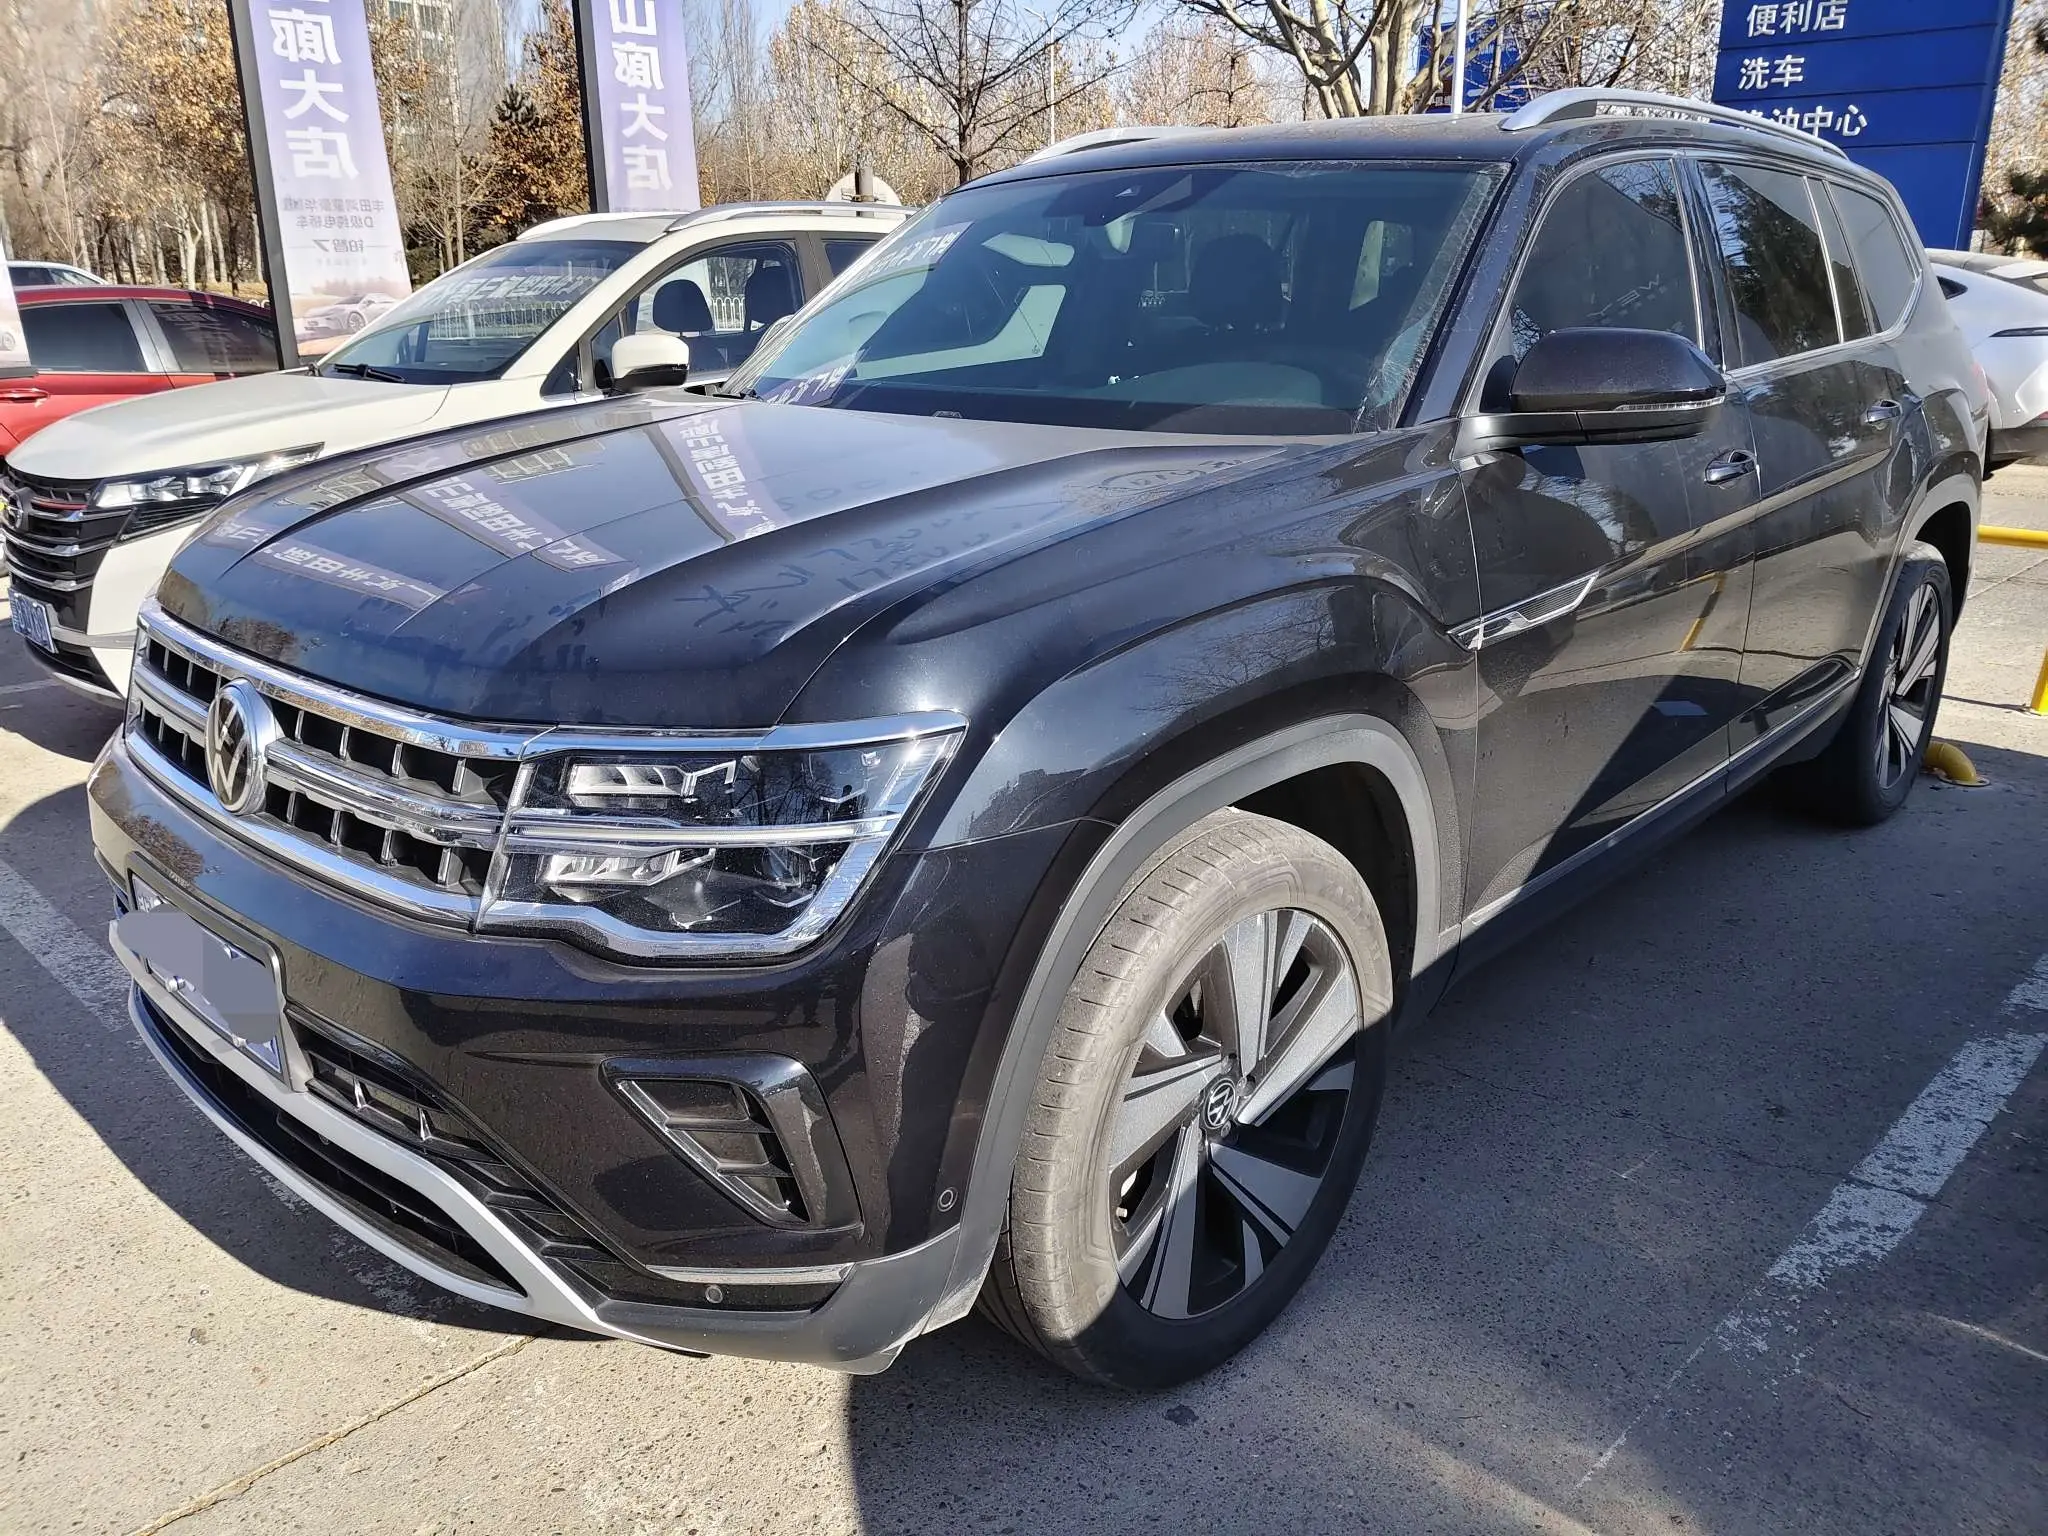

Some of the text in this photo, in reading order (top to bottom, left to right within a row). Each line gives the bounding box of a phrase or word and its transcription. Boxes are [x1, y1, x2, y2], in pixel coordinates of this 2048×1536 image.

[1746, 0, 1848, 37] 便利店
[1738, 54, 1805, 90] 洗车
[1741, 104, 1867, 137] 油中心
